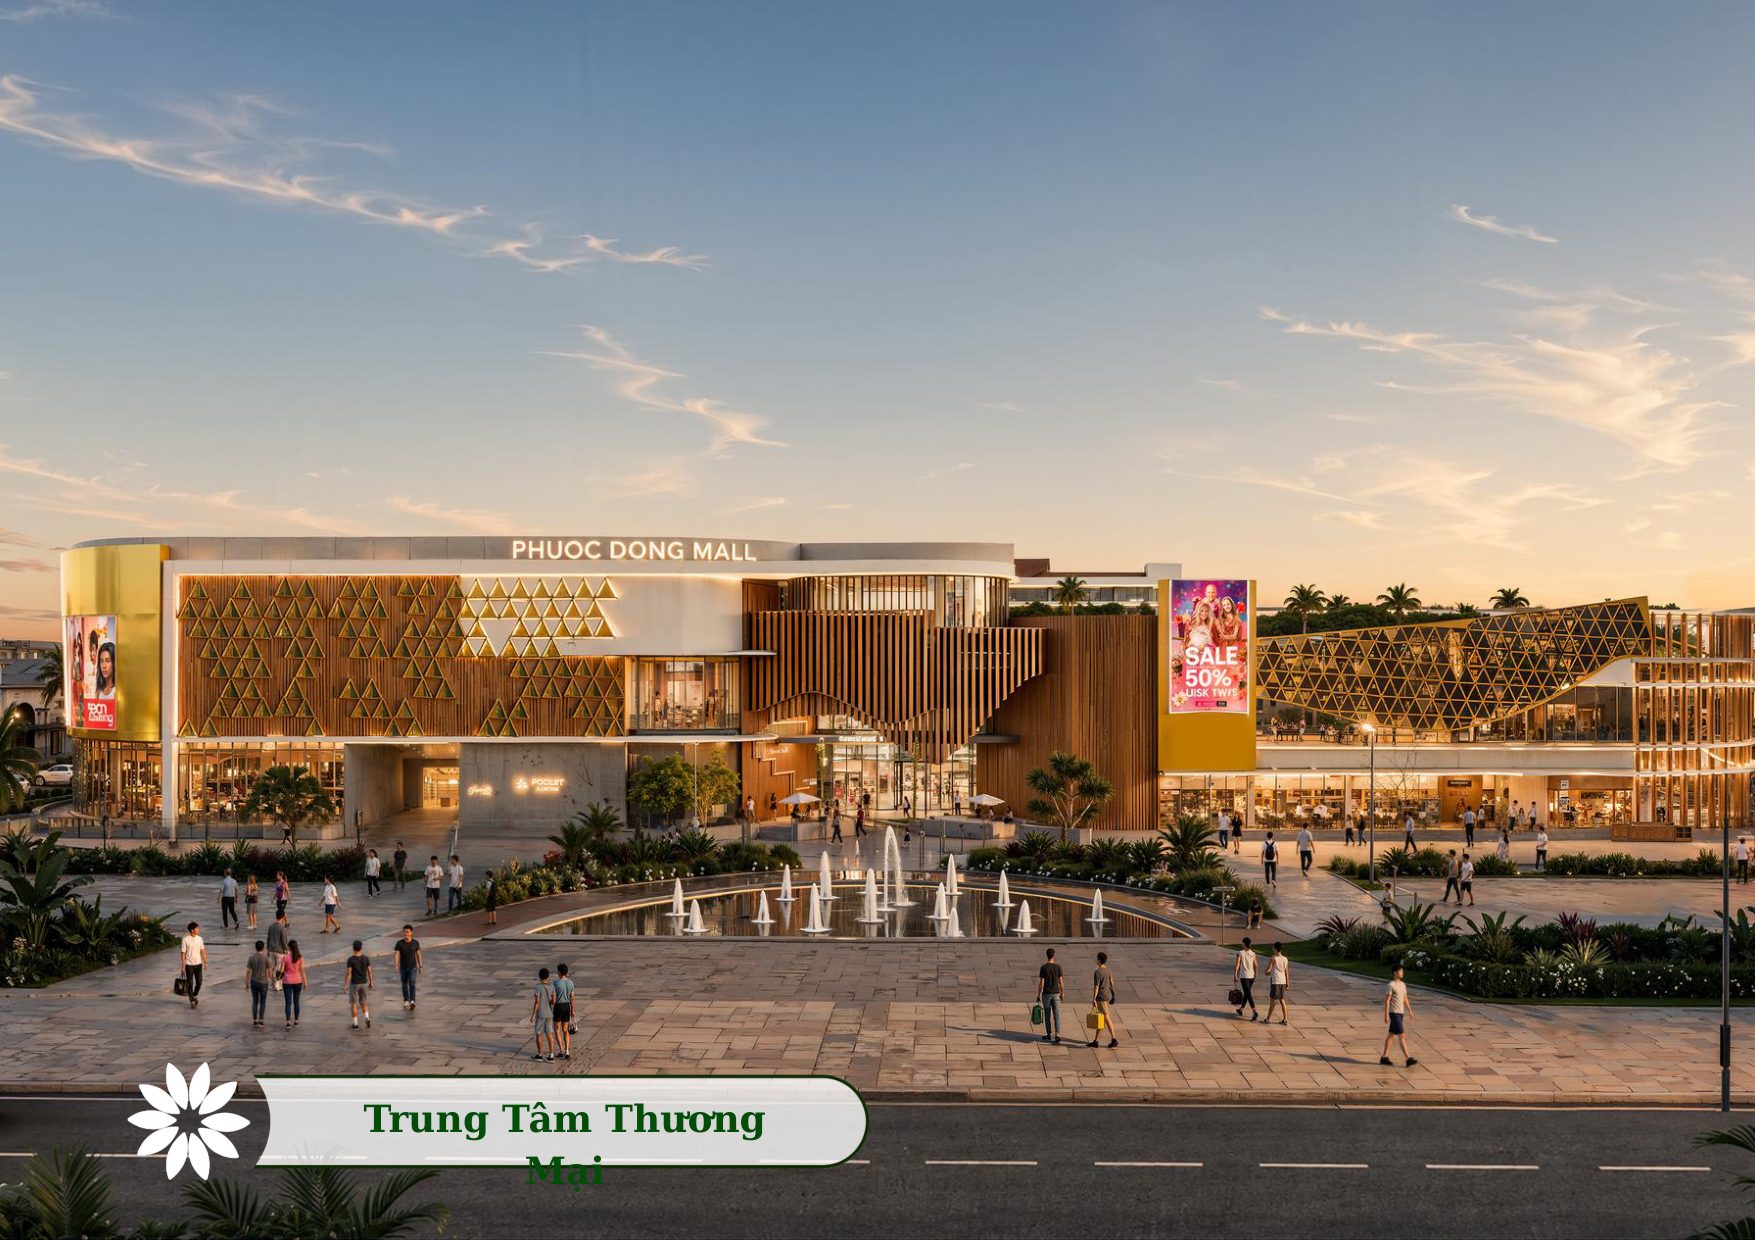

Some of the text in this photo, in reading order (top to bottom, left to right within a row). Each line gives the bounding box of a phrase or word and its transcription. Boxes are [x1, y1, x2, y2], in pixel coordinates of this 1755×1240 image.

[511, 540, 757, 561] PHUOC DONG MALL
[1185, 646, 1239, 666] SALE
[1185, 668, 1232, 688] 50%
